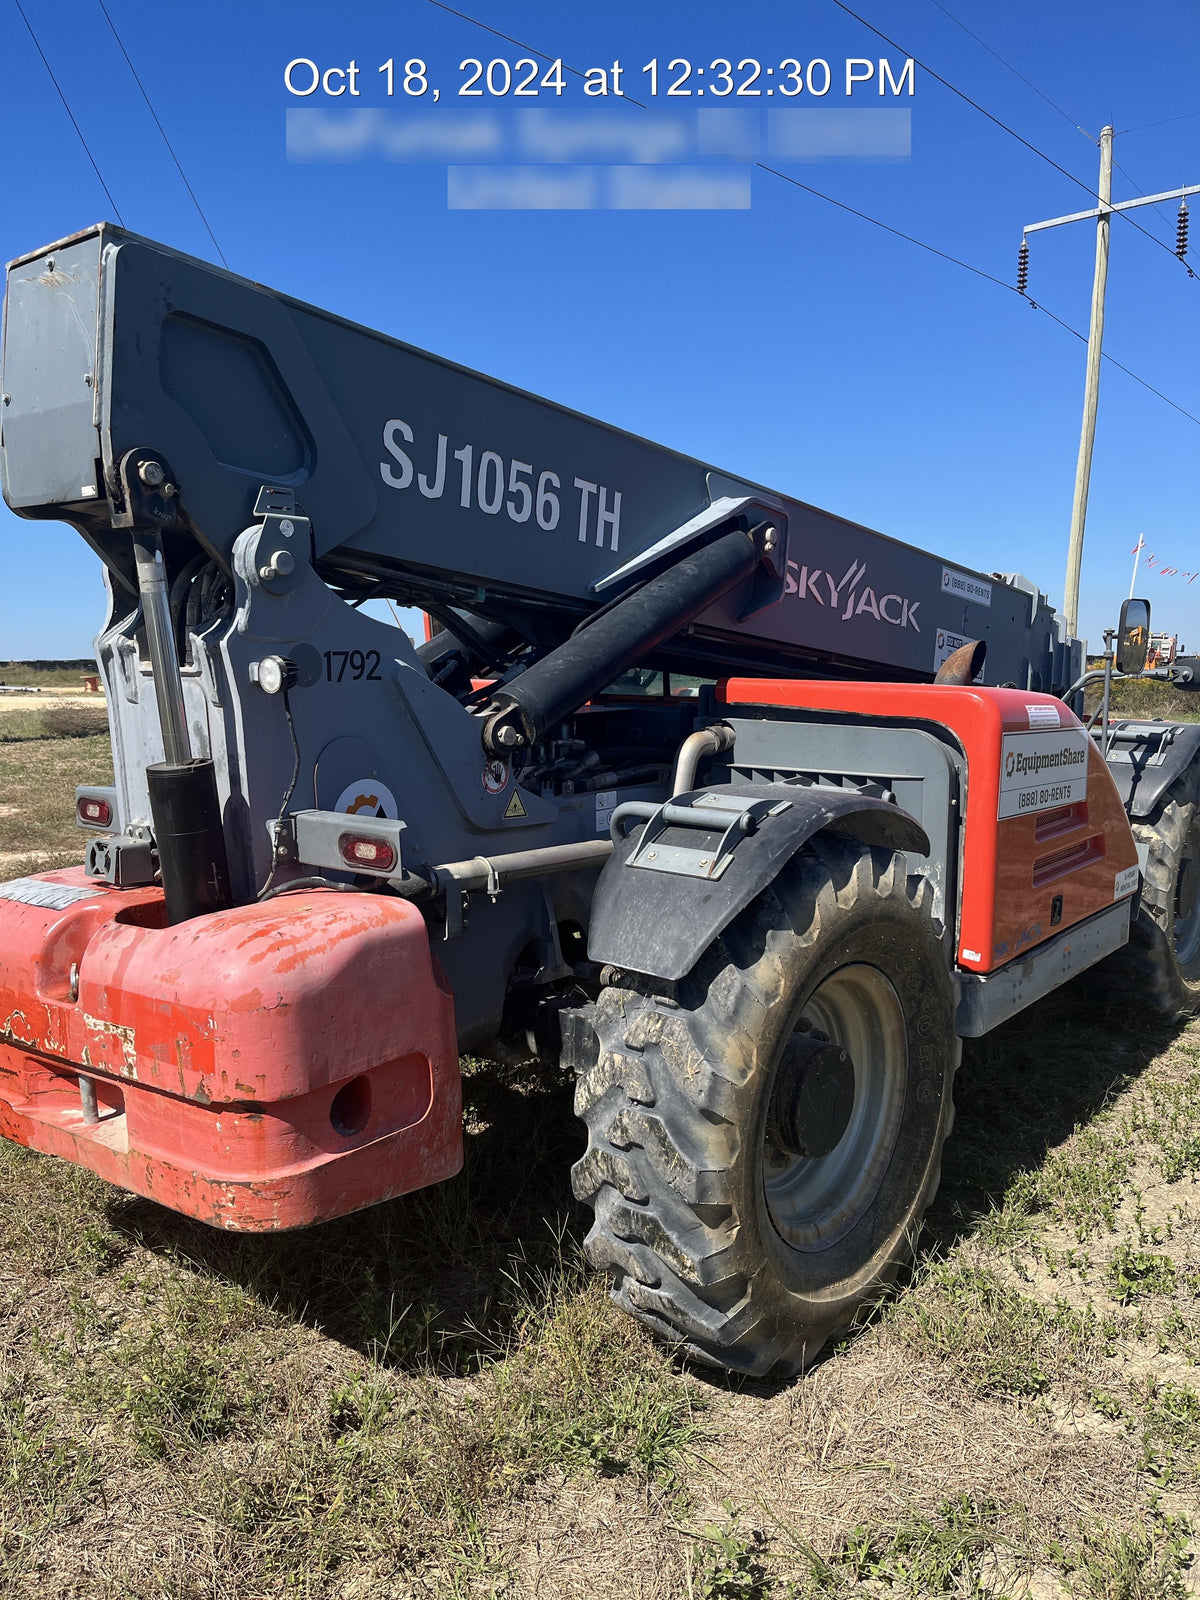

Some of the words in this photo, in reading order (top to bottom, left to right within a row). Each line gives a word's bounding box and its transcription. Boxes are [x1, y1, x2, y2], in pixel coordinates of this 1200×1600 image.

[380, 419, 561, 531] SJ1056
[574, 476, 622, 552] TH
[784, 559, 921, 633] SKYJACK
[951, 576, 966, 592] (888)
[966, 584, 990, 599] 80-RENTS
[323, 649, 382, 682] 1792
[1016, 748, 1085, 776] EquipmentShare
[1018, 790, 1038, 809] (888)
[1039, 785, 1072, 804] 80-RENTS
